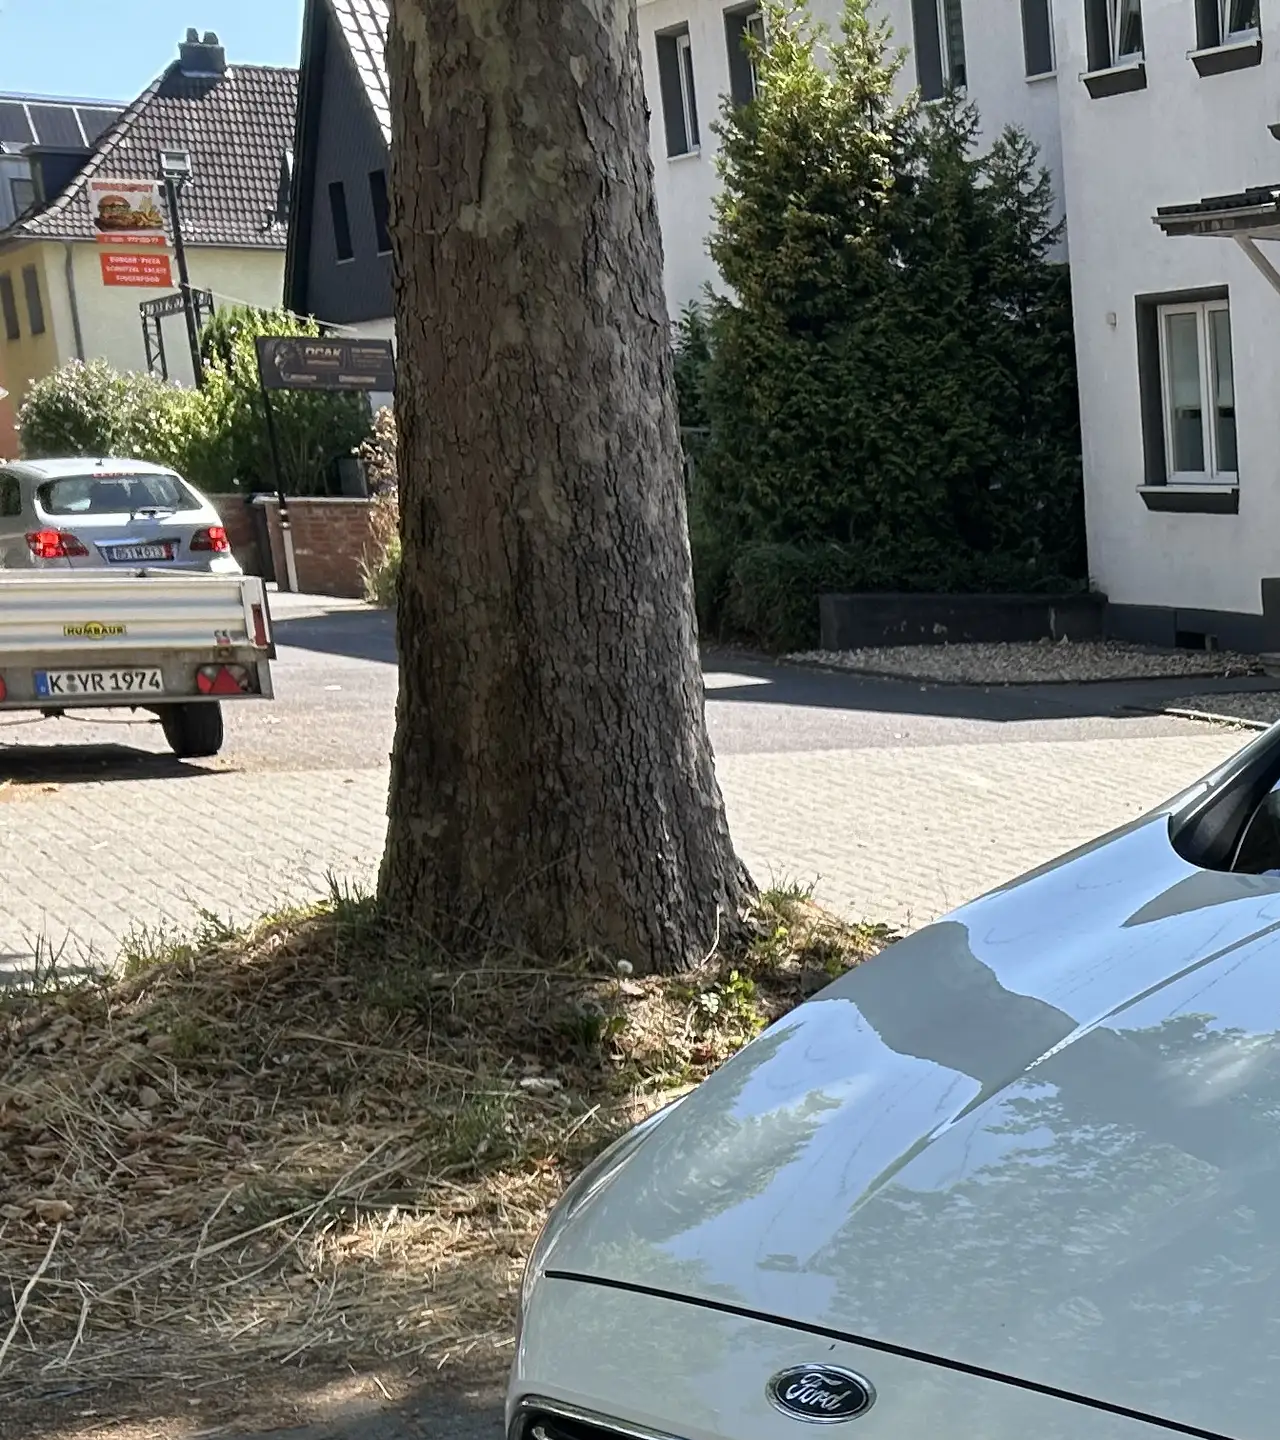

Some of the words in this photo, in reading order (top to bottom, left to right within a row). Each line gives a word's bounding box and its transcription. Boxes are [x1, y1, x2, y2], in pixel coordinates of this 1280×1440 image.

[67, 626, 124, 637] HUMBAUR
[49, 674, 64, 693] K
[78, 673, 105, 692] YR
[110, 671, 161, 690] 1974
[785, 1372, 852, 1411] Ford
